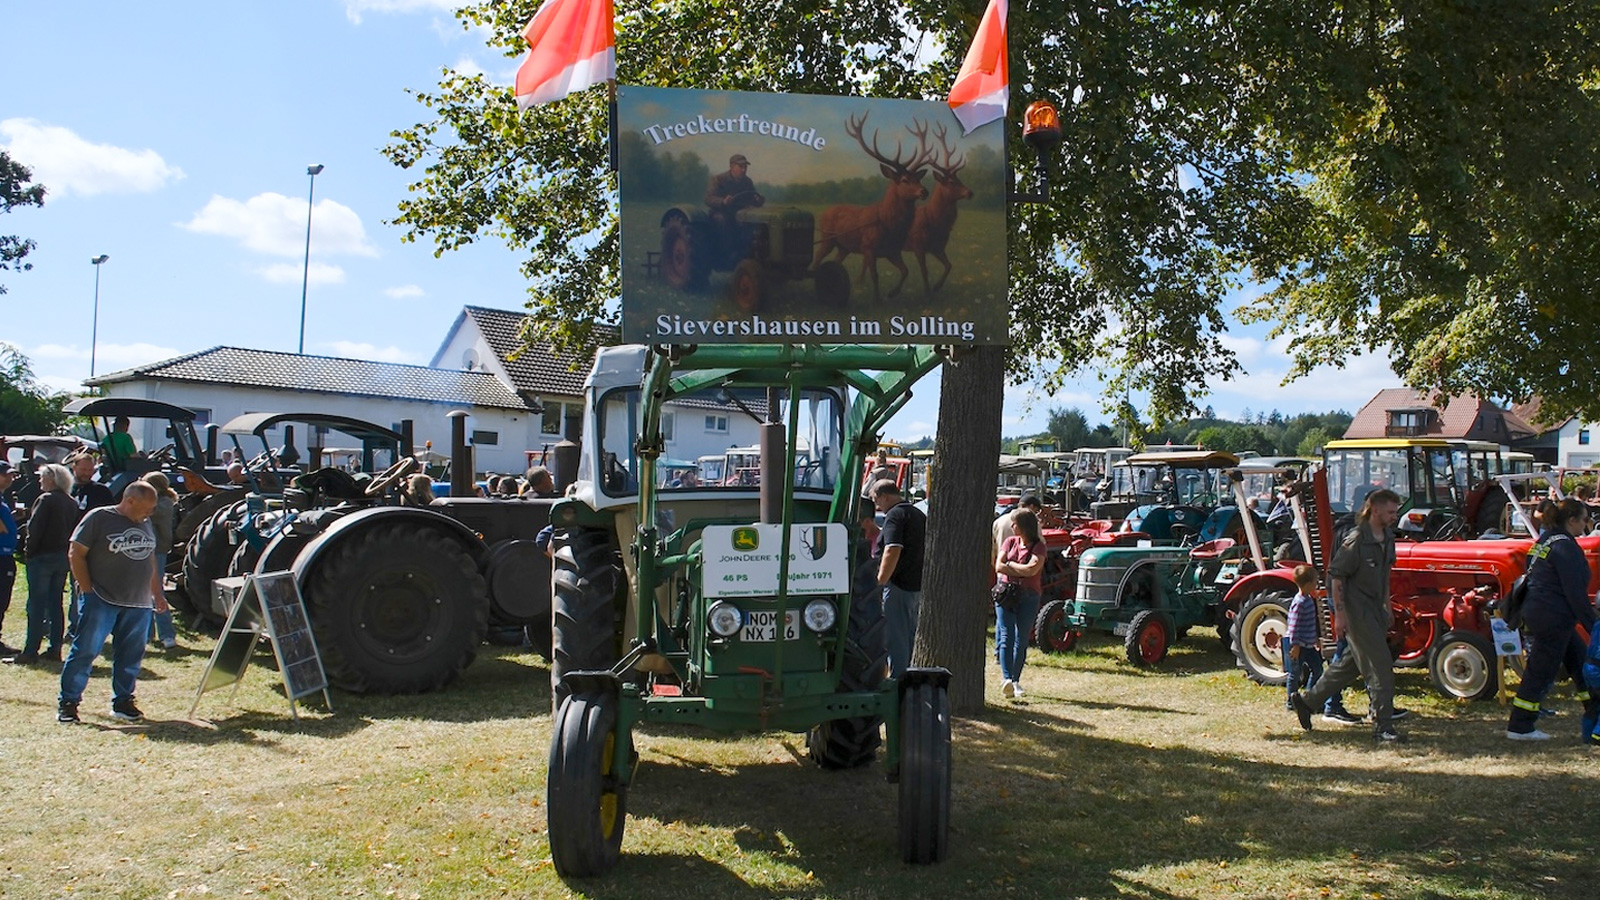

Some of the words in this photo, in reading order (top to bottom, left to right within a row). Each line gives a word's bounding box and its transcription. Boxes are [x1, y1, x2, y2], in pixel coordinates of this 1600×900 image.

[643, 113, 827, 151] Treckerfreunde
[656, 314, 841, 336] Sievershausen
[850, 315, 881, 336] im
[890, 315, 975, 341] Solling
[719, 555, 742, 563] JOHN
[743, 554, 771, 562] DEERE
[776, 572, 810, 581] Bujahr
[812, 571, 832, 579] 1971
[750, 613, 777, 626] NOM
[746, 627, 764, 641] NX
[769, 626, 795, 641] 16
